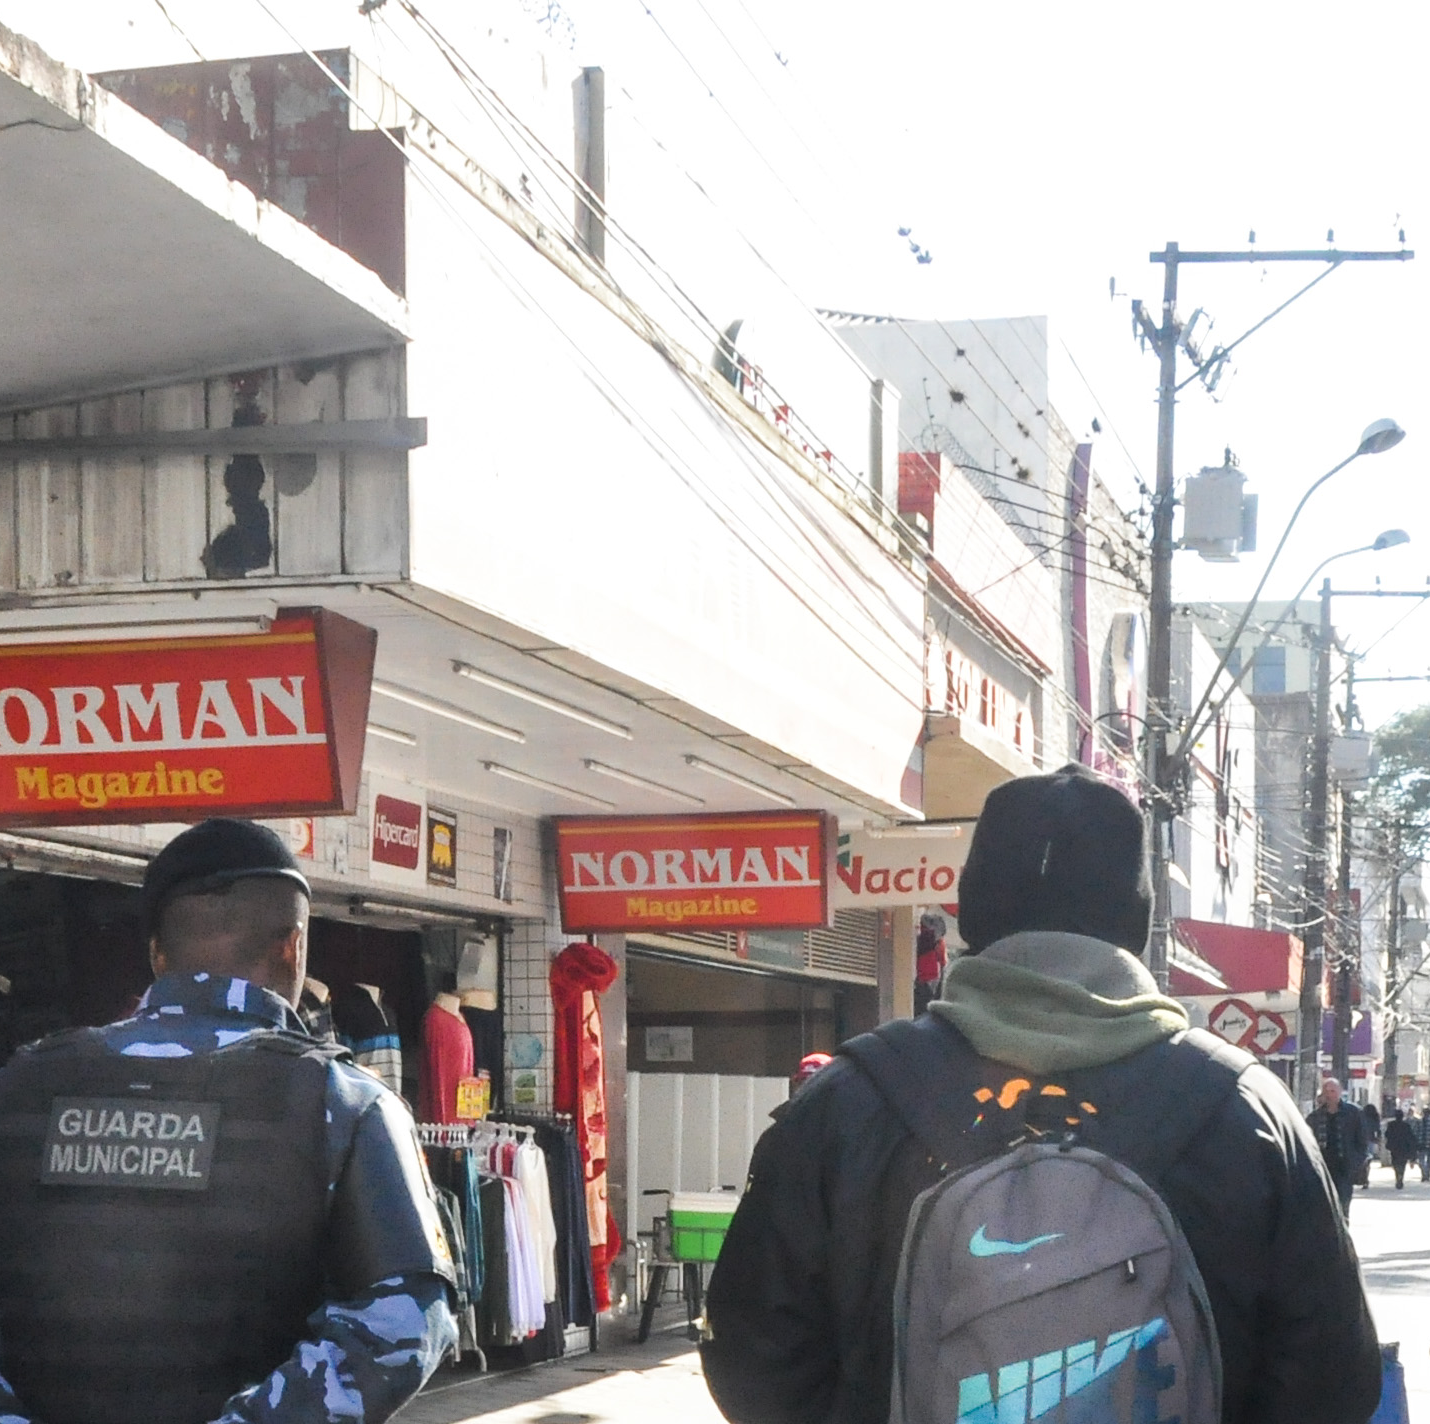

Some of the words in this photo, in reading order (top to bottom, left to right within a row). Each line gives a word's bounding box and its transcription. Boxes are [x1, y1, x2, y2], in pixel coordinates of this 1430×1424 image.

[15, 761, 225, 808] Magazine
[375, 815, 418, 848] Hipercard
[570, 845, 812, 889] NORMAN
[836, 856, 964, 895] Nacio
[627, 895, 759, 922] Magazine
[58, 1109, 205, 1142] GUARDA
[50, 1143, 203, 1179] MUNICIPAL
